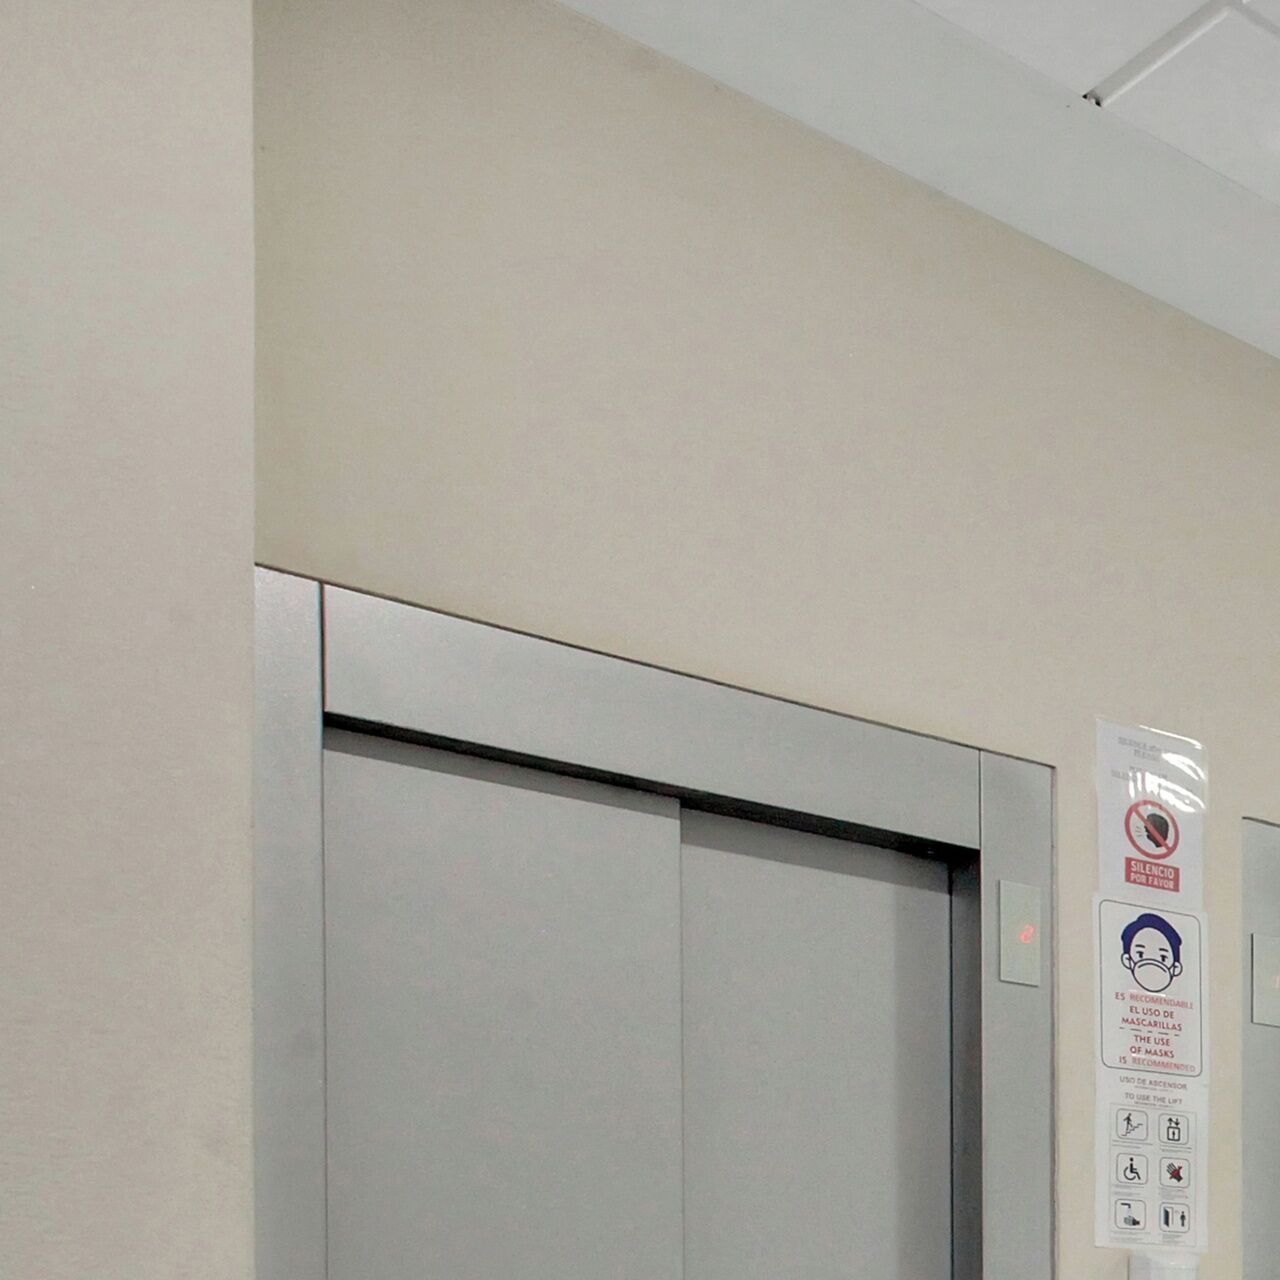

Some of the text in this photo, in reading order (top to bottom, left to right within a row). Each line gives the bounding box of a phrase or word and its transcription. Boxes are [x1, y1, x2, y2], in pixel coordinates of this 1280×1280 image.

[1130, 861, 1174, 879] SILENCIO
[1130, 873, 1174, 889] POR FAVOR
[1115, 992, 1126, 1001] ES
[1129, 1006, 1175, 1019] EL USO DE
[1122, 1017, 1182, 1032] MASCARILLAS
[1134, 1034, 1170, 1047] THE USE
[1130, 1046, 1175, 1059] OF MASKS
[1119, 1056, 1196, 1072] IS RECOMMENDED
[1120, 1076, 1135, 1084] USO
[1149, 1080, 1188, 1090] ASCENSOR
[1125, 1092, 1135, 1100] TO
[1136, 1094, 1150, 1102] USE
[1153, 1095, 1166, 1104] THE
